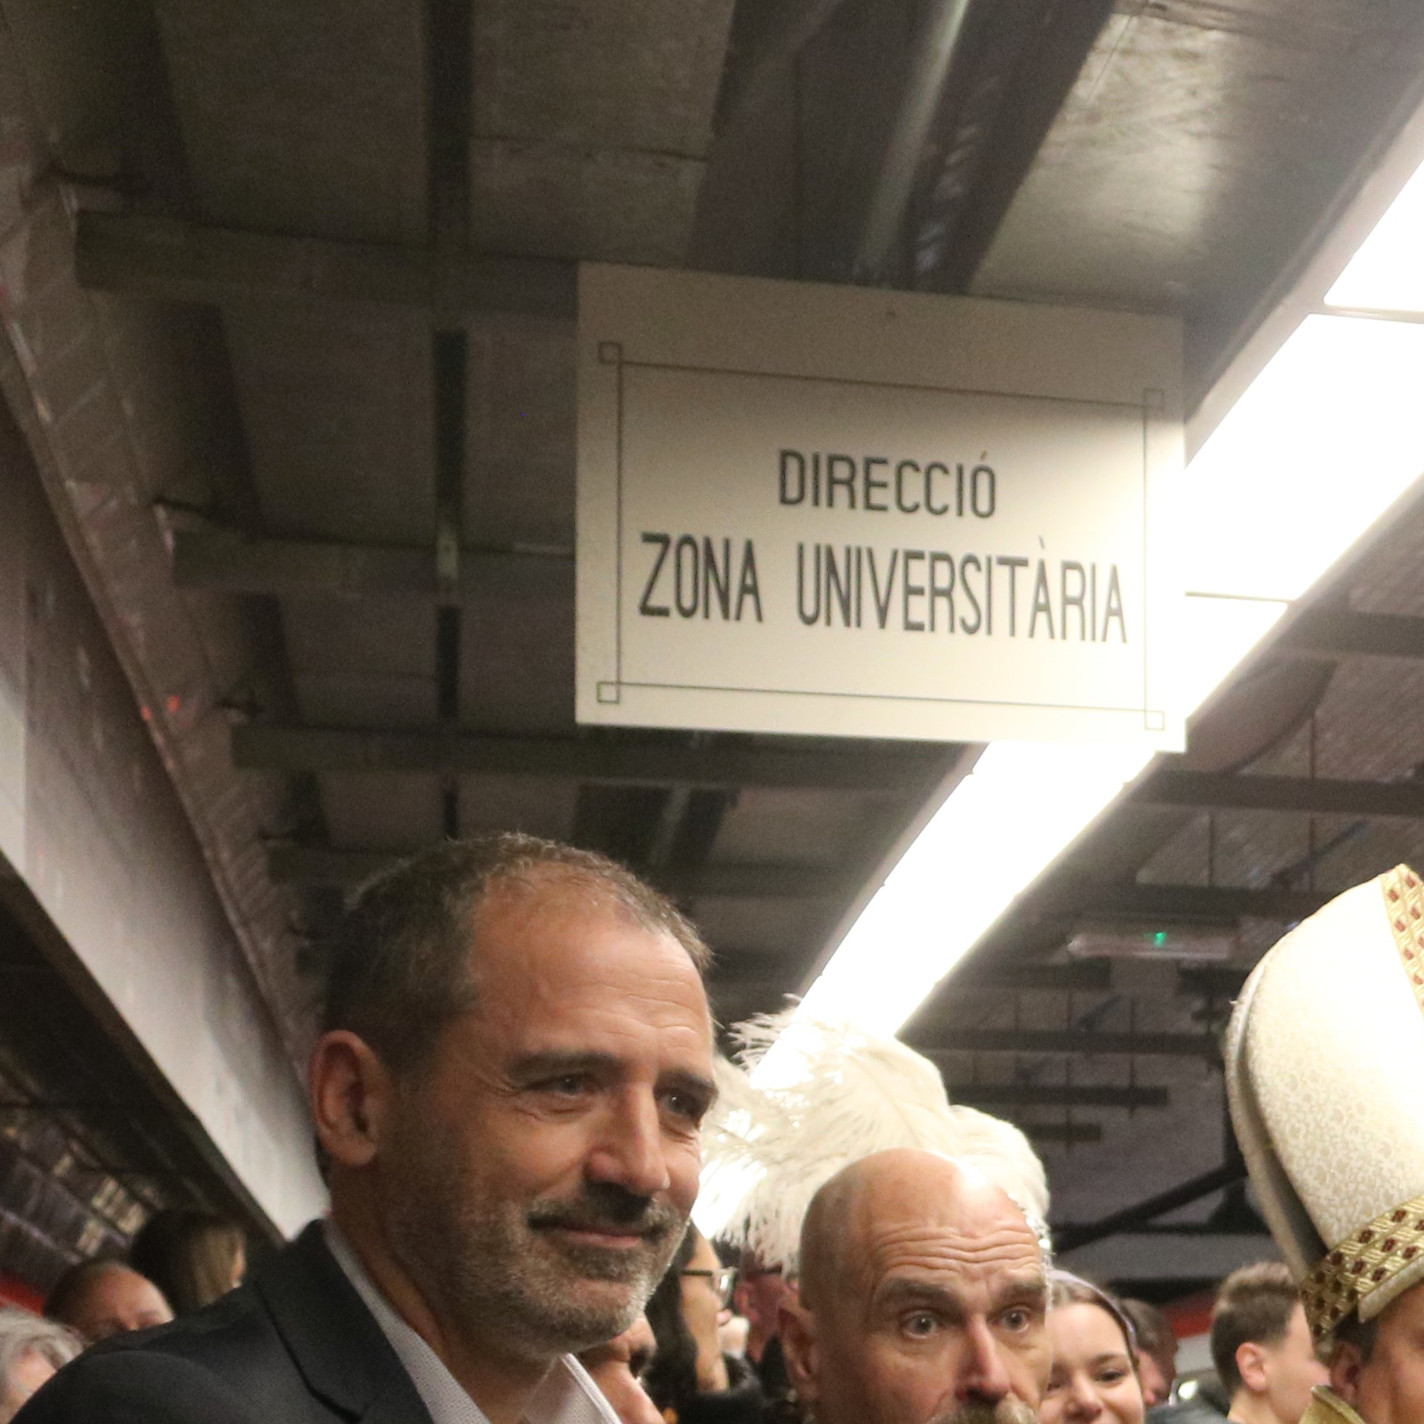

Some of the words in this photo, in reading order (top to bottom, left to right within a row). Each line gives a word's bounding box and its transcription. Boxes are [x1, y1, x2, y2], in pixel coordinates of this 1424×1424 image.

[778, 448, 997, 519] DIRECCIÓ
[638, 531, 764, 623] ZONA
[797, 536, 1128, 645] UNIVERSITÀRIA
